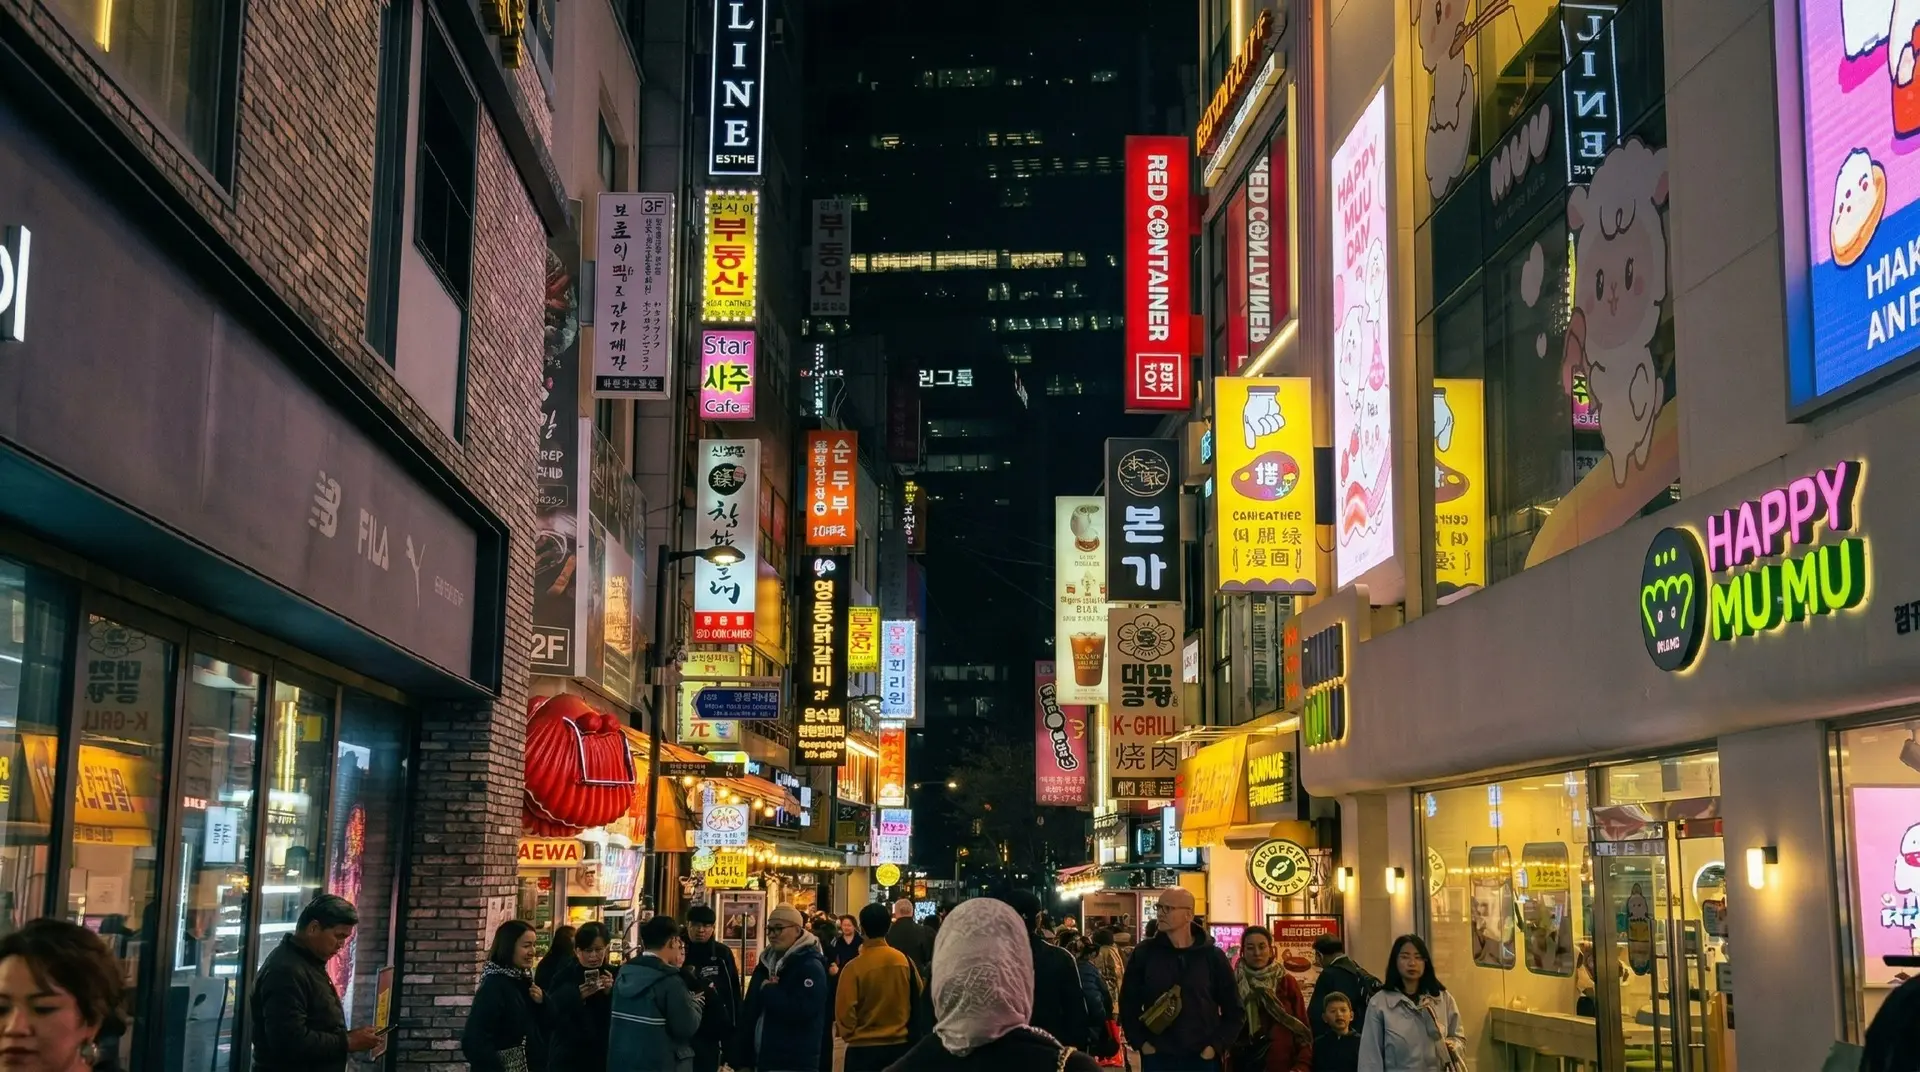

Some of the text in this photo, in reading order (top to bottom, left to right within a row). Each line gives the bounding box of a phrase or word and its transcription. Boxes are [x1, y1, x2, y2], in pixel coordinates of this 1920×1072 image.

[714, 154, 755, 164] ESTHE
[1338, 134, 1377, 211] HAPPY
[644, 200, 664, 213] 3F
[711, 218, 749, 296] 부동산
[1148, 154, 1170, 342] RED CONTAINER
[704, 336, 751, 355] Star
[704, 364, 751, 392] 사주
[704, 399, 741, 413] Cafe
[831, 439, 851, 516] 순두부
[1708, 460, 1847, 571] HAPPY
[357, 507, 390, 572] FILA
[1121, 505, 1167, 591] 본가
[530, 633, 565, 661] 2F
[814, 690, 829, 701] 2F
[1113, 715, 1179, 736] K-GRILL
